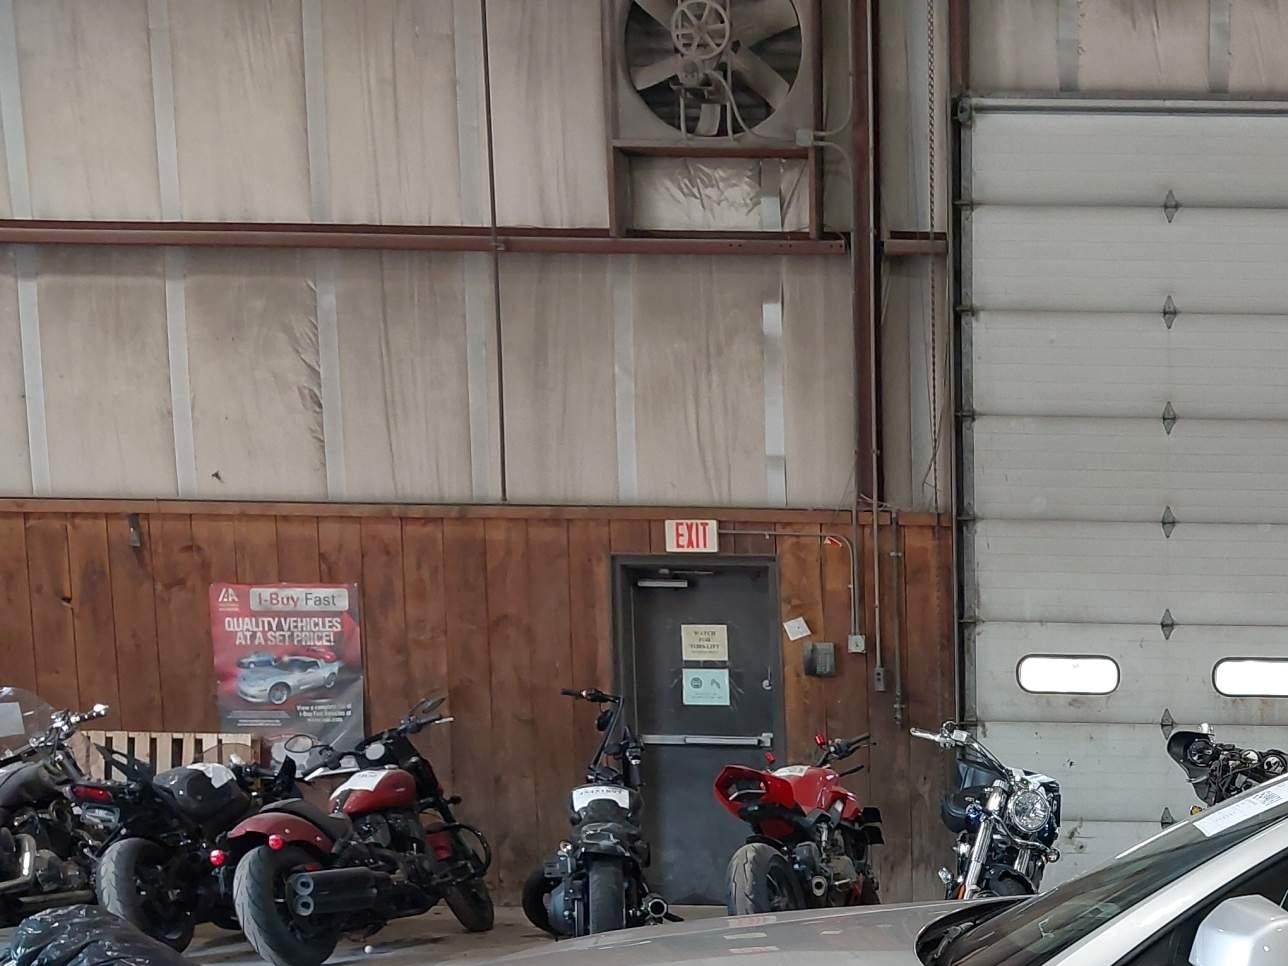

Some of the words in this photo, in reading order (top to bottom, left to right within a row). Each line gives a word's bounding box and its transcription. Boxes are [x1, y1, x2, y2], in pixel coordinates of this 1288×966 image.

[675, 522, 709, 548] EXIT
[258, 592, 298, 608] I-Buy
[304, 592, 337, 606] Fast
[225, 617, 278, 632] QUALITY
[281, 617, 341, 632] VEHICLES
[235, 631, 254, 645] AT
[255, 631, 266, 645] A
[267, 631, 292, 645] SET
[294, 631, 335, 646] PRICE!
